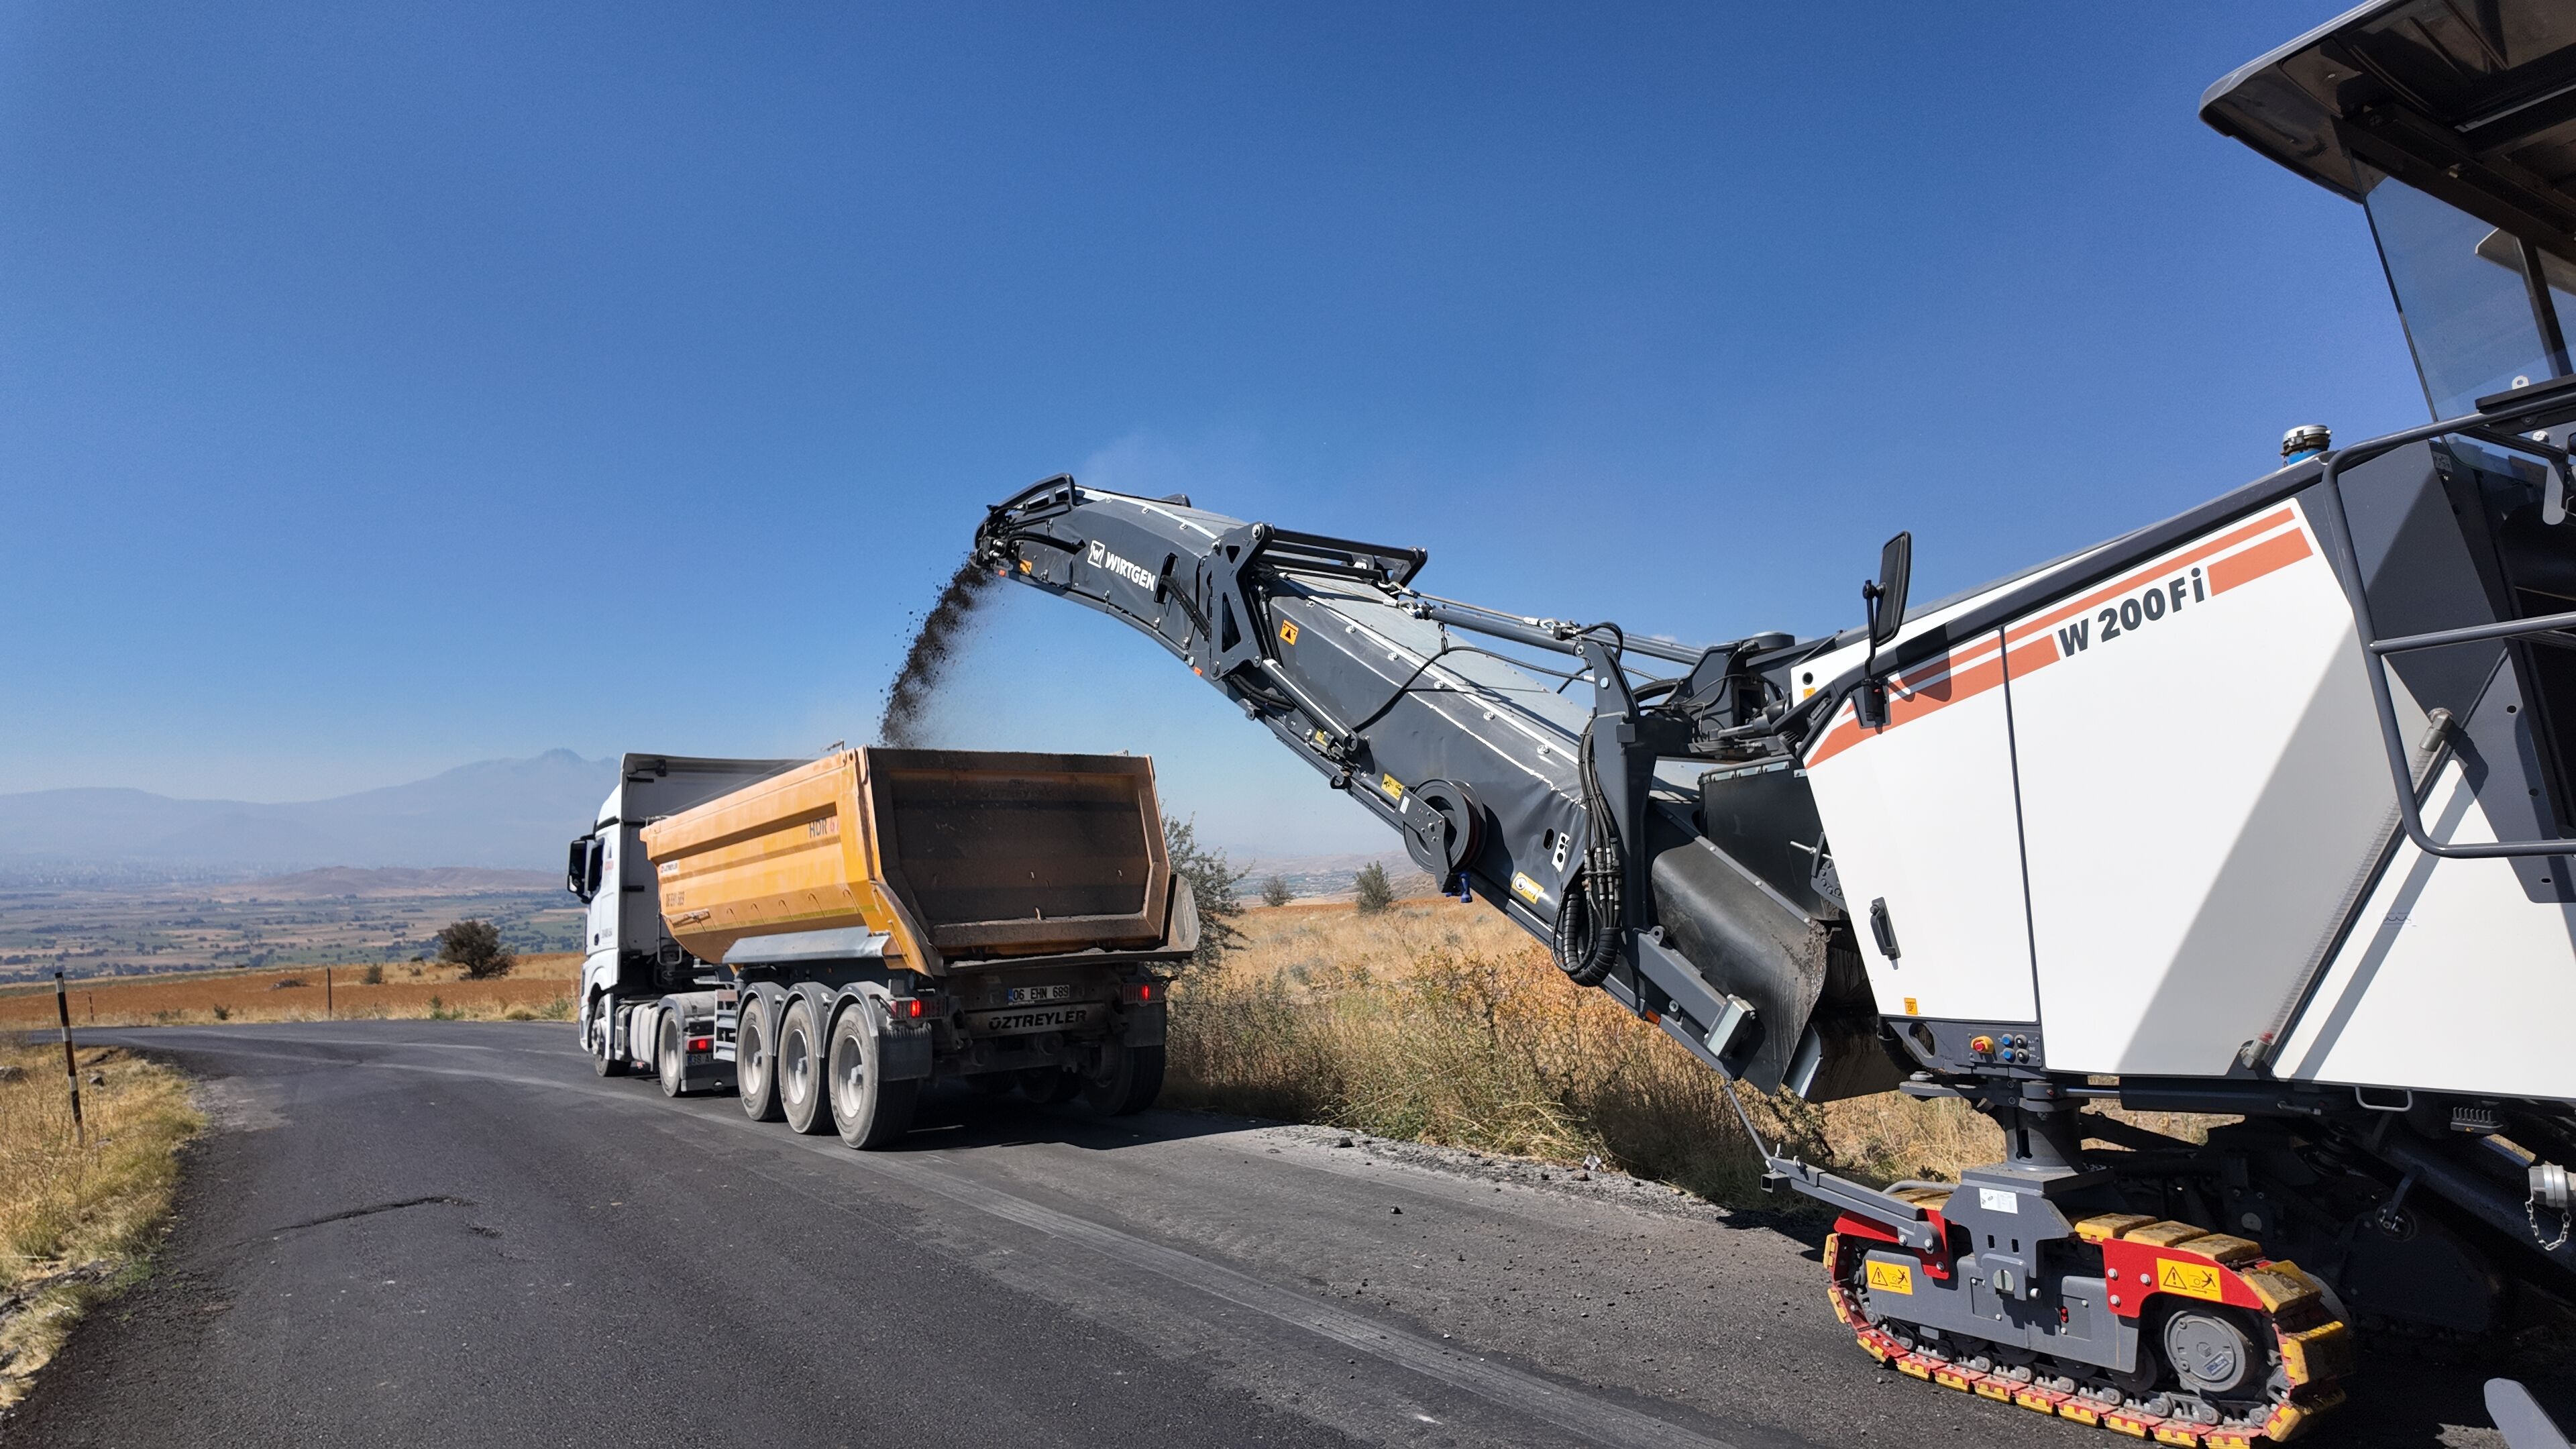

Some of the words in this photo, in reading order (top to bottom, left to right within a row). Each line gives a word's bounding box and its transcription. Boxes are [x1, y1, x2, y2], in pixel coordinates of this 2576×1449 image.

[1105, 551, 1156, 592] WIRTGEN
[2057, 617, 2089, 657] W
[808, 817, 828, 839] HDR
[1013, 989, 1024, 1000] 06
[1030, 987, 1047, 1000] EHN
[1053, 985, 1069, 998] 689
